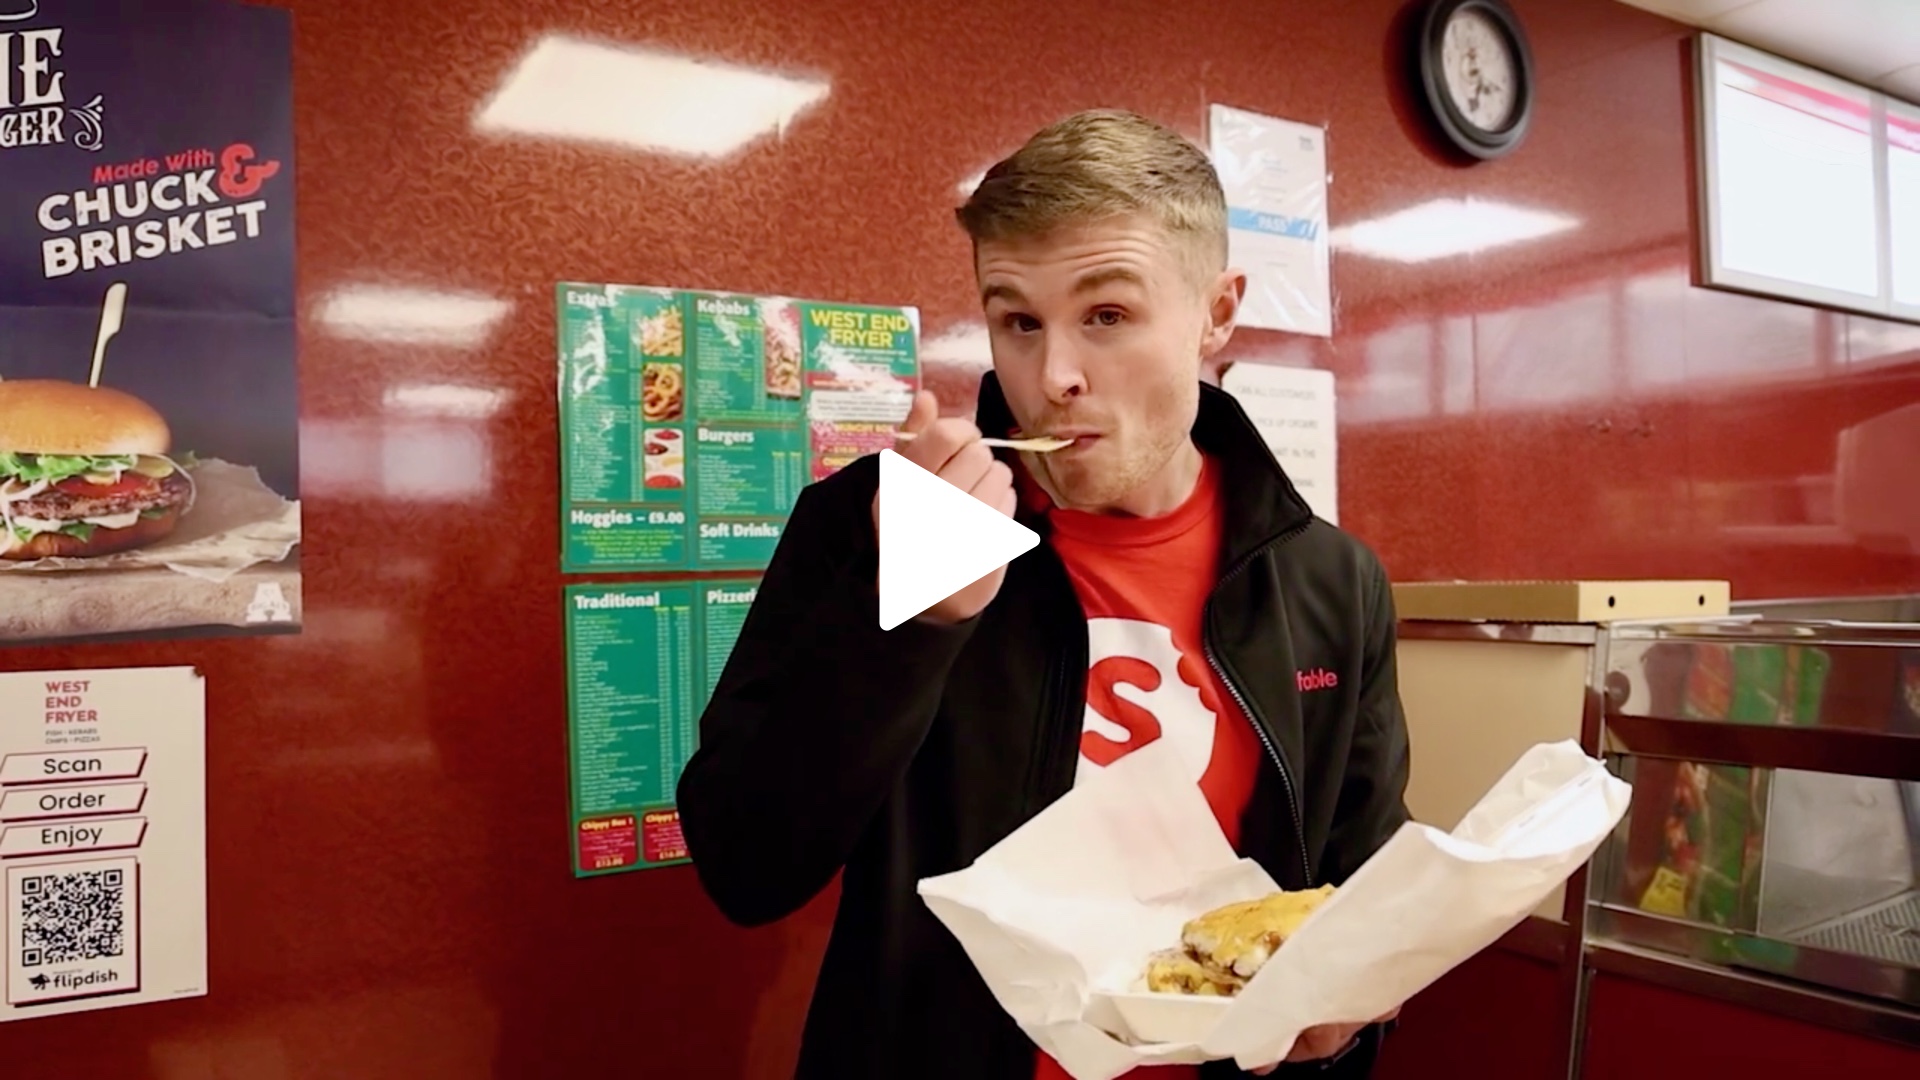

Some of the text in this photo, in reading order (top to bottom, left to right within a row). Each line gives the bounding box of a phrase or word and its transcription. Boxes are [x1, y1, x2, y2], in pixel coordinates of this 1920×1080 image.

[93, 158, 159, 184] Made
[37, 143, 280, 231] CHUCK &
[42, 200, 267, 278] BRISKET
[697, 299, 750, 316] Kebabs
[810, 309, 909, 332] WEST END
[830, 329, 893, 348] FRYER
[697, 427, 755, 446] Burgers
[571, 509, 633, 528] Hoggies
[648, 511, 685, 524] £9.00
[700, 522, 779, 538] Soft Drinks
[574, 591, 660, 609] Traditional
[45, 680, 91, 693] WEST
[46, 695, 82, 708] END
[45, 710, 97, 724] FRYER
[43, 758, 102, 774] Scan
[39, 792, 105, 811] Order
[41, 825, 103, 848] Enjoy
[53, 970, 118, 990] flipdish
